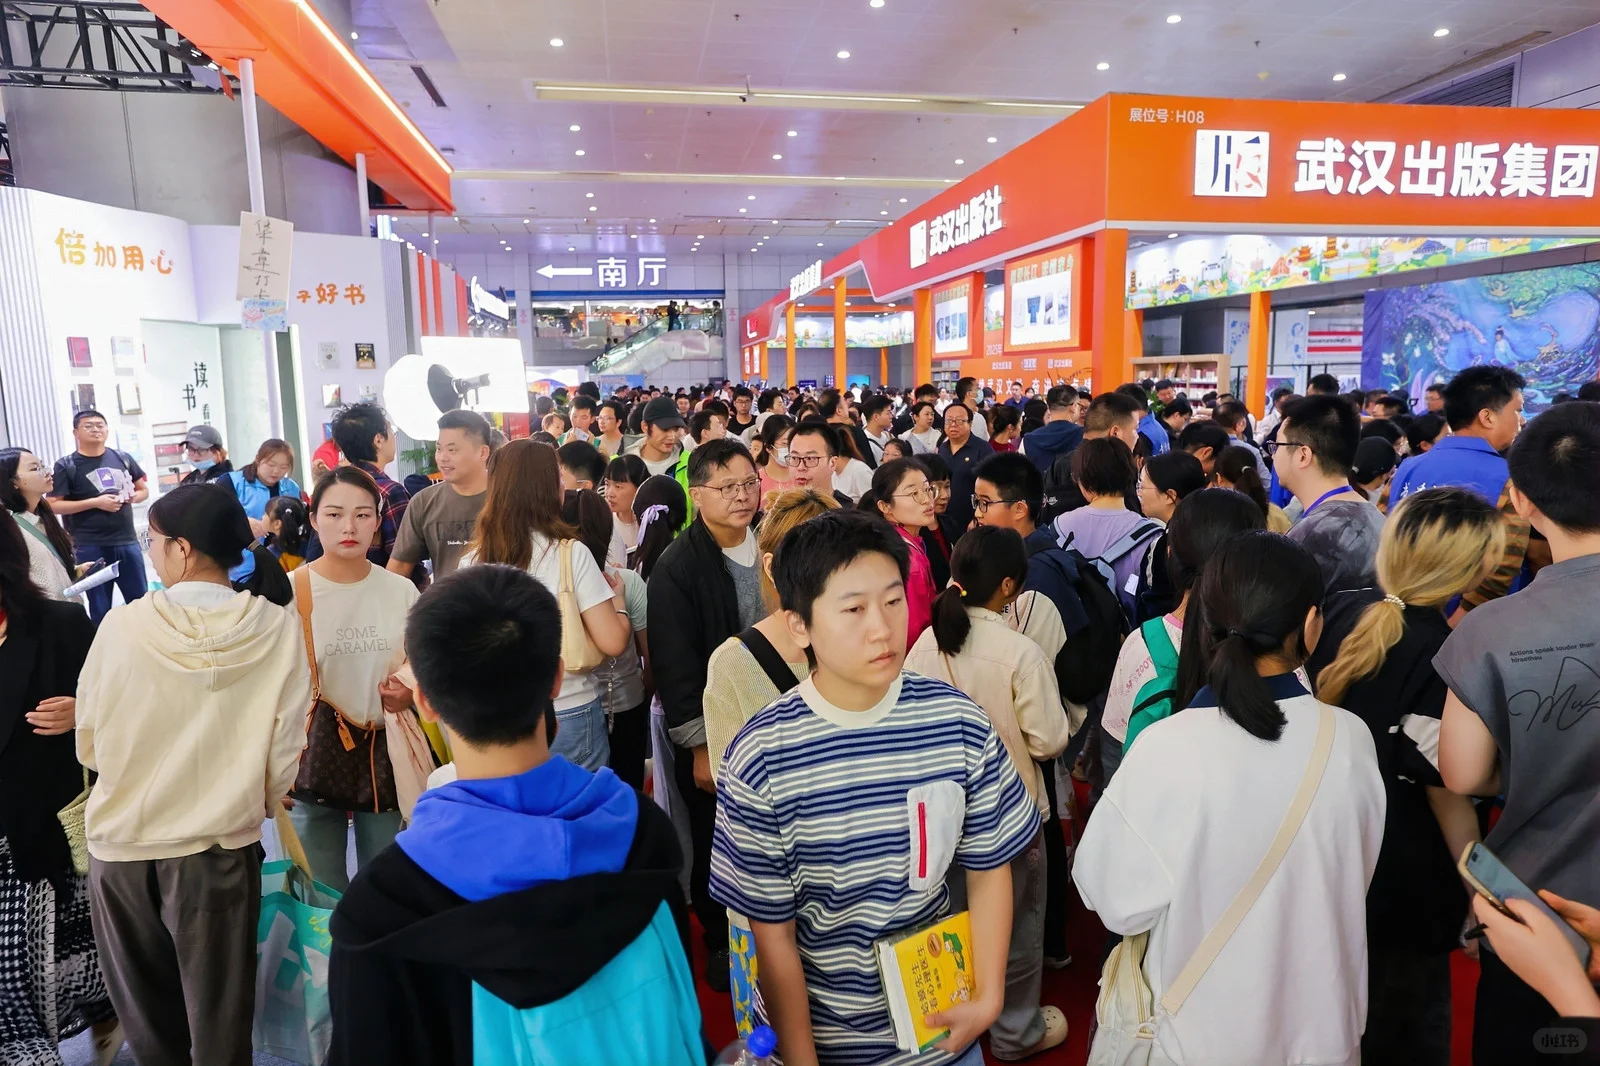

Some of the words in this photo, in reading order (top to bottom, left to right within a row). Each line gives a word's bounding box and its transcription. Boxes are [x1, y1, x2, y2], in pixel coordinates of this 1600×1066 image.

[1294, 137, 1599, 198] 武汉出版集团
[929, 184, 1003, 257] 武汉出版社
[54, 227, 176, 276] 倍加用心
[596, 256, 667, 288] 南厅
[324, 638, 392, 657] CARAMEL
[336, 625, 379, 641] SOME
[1509, 649, 1534, 657] Actions
[1534, 646, 1555, 655] speak
[1555, 643, 1578, 652] louder
[1578, 641, 1595, 650] than
[916, 944, 941, 1014] 看心理医生
